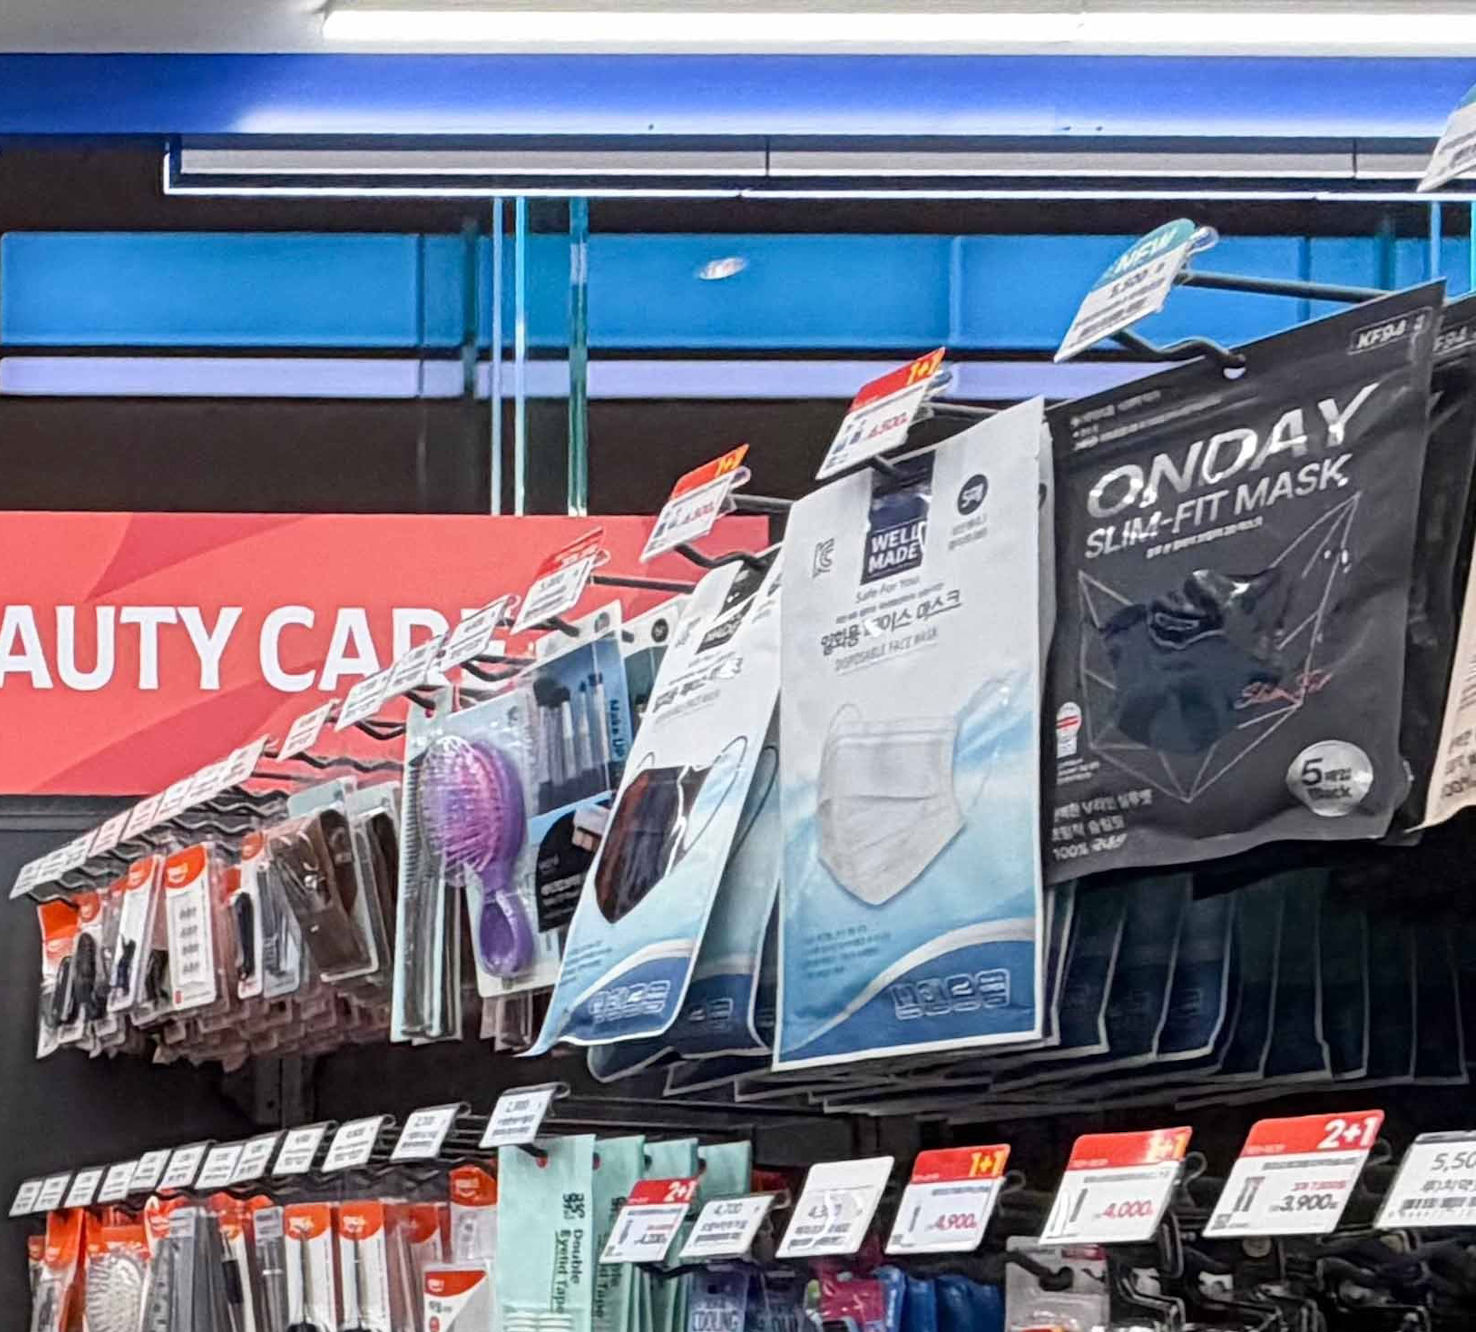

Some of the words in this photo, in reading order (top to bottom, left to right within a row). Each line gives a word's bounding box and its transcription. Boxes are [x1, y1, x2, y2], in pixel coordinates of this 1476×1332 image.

[1085, 381, 1381, 520] ONDAY
[1084, 491, 1231, 560] SLIM-FIT
[1233, 453, 1355, 523] MASK
[870, 522, 924, 553] WELL
[867, 548, 921, 576] MADE
[1146, 1131, 1188, 1163] 1+1
[1316, 1116, 1379, 1151] 2+1
[969, 1149, 1007, 1178] 1+1
[663, 1181, 698, 1203] 2+1
[555, 1229, 572, 1275] Eyelid
[569, 1228, 585, 1286] Double
